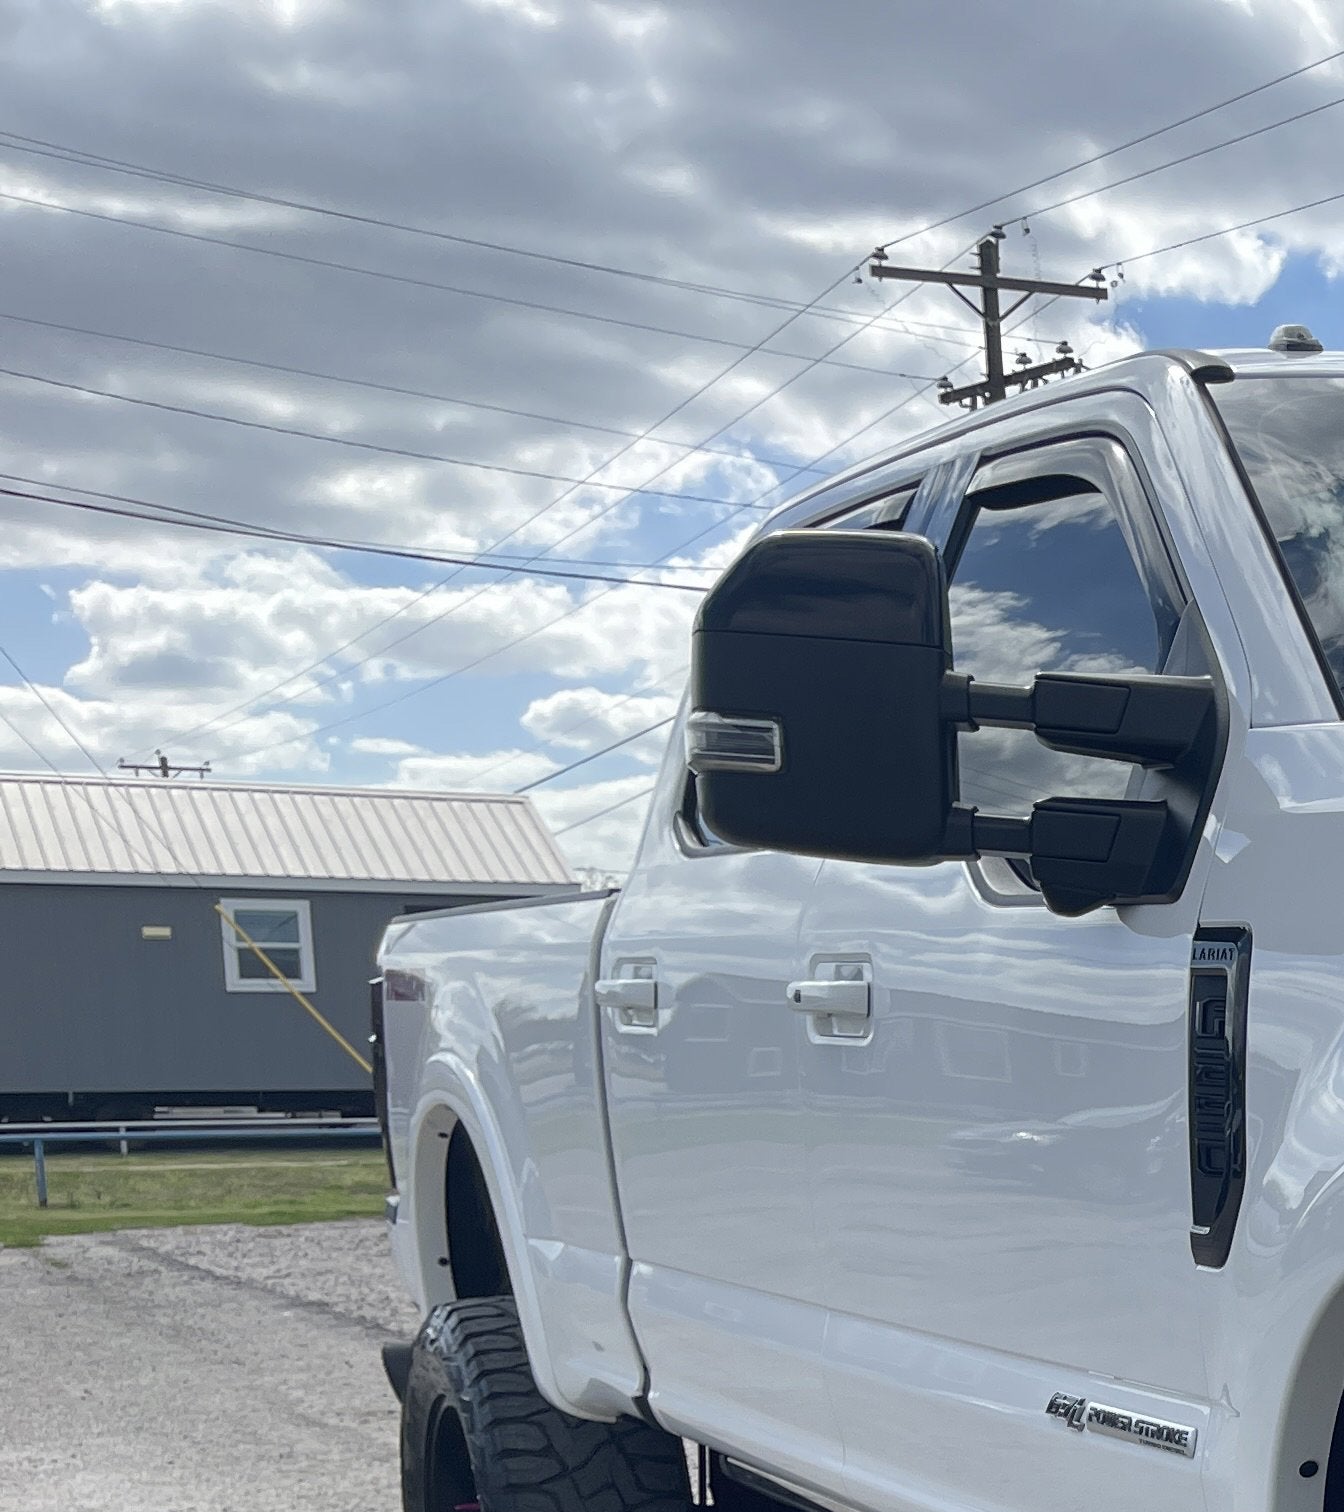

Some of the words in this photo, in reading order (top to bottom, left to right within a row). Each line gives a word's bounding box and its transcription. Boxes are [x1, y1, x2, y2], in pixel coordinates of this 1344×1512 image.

[1192, 947, 1235, 961] LARIAT
[1087, 1406, 1133, 1433] POWER
[1133, 1419, 1189, 1448] STROKE
